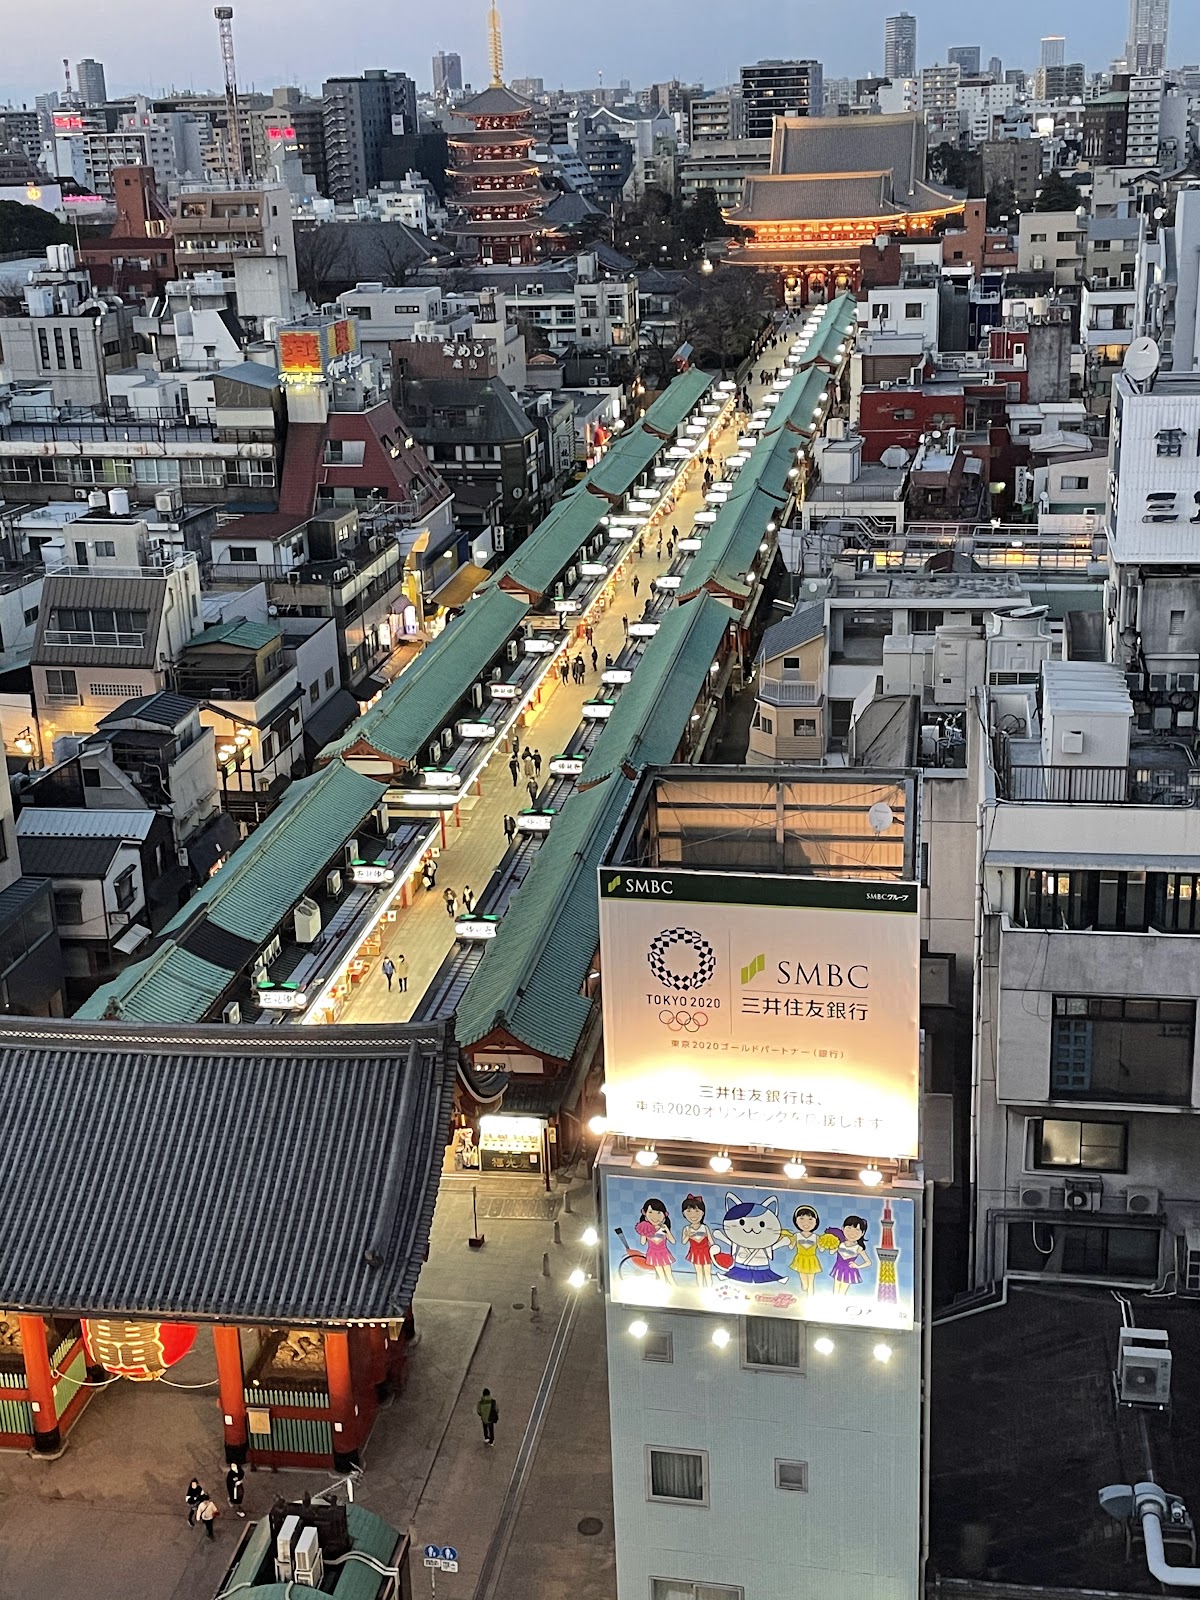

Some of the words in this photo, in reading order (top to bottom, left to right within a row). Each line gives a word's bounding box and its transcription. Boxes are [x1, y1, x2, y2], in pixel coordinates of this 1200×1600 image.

[625, 878, 673, 894] SMBC
[865, 892, 909, 902] SMBCグループ
[777, 960, 869, 989] SMBC
[647, 993, 687, 1007] TOKYO
[690, 996, 721, 1009] 2020
[742, 996, 869, 1021] 三井住友銀行
